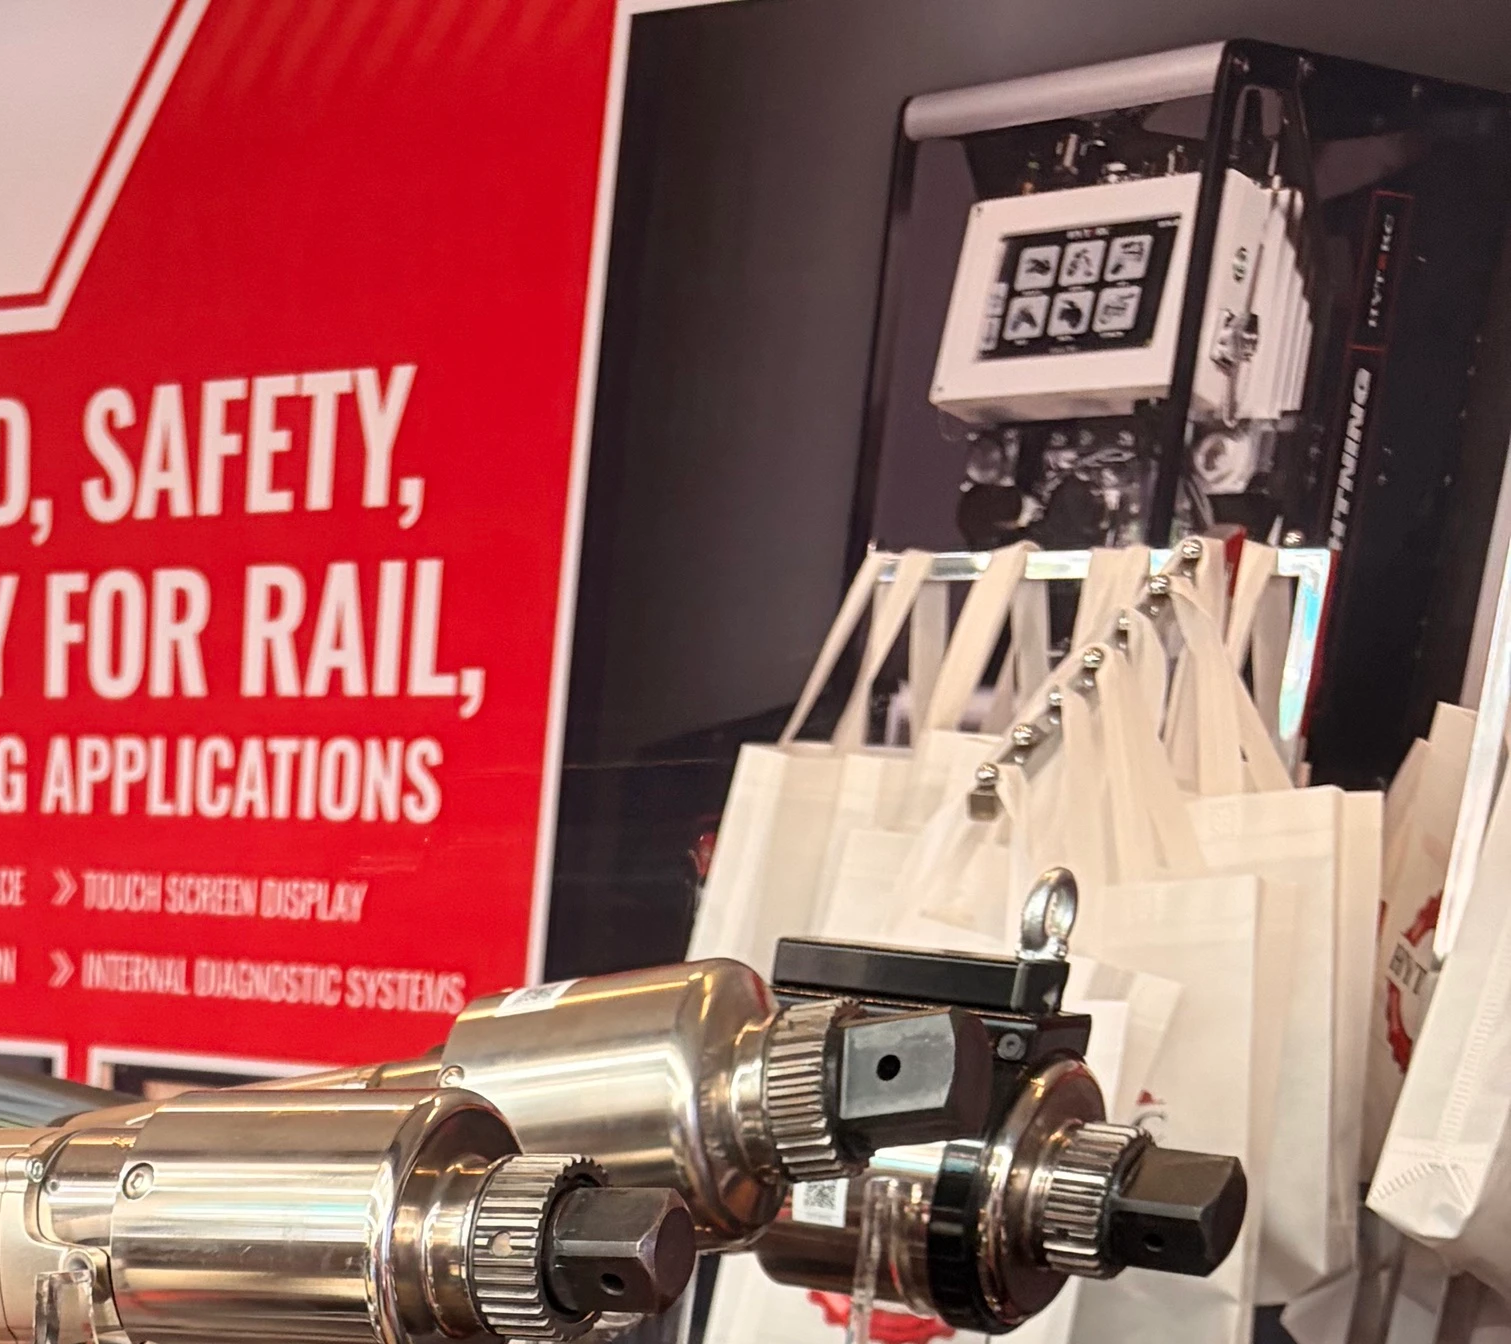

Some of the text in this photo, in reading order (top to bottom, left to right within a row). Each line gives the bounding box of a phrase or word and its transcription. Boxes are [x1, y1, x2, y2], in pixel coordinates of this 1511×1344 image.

[82, 364, 425, 530] SAFETY,
[1327, 367, 1373, 551] HTNING
[44, 568, 211, 701] FOR
[240, 558, 485, 719] RAIL,
[41, 734, 444, 825] APPLICATIONS
[83, 871, 368, 923] TOUCH SCREEN DISPLAY
[82, 951, 466, 1016] INTERNAL DIAGNOSTIC SYSTEMS
[1389, 942, 1428, 995] HYT
